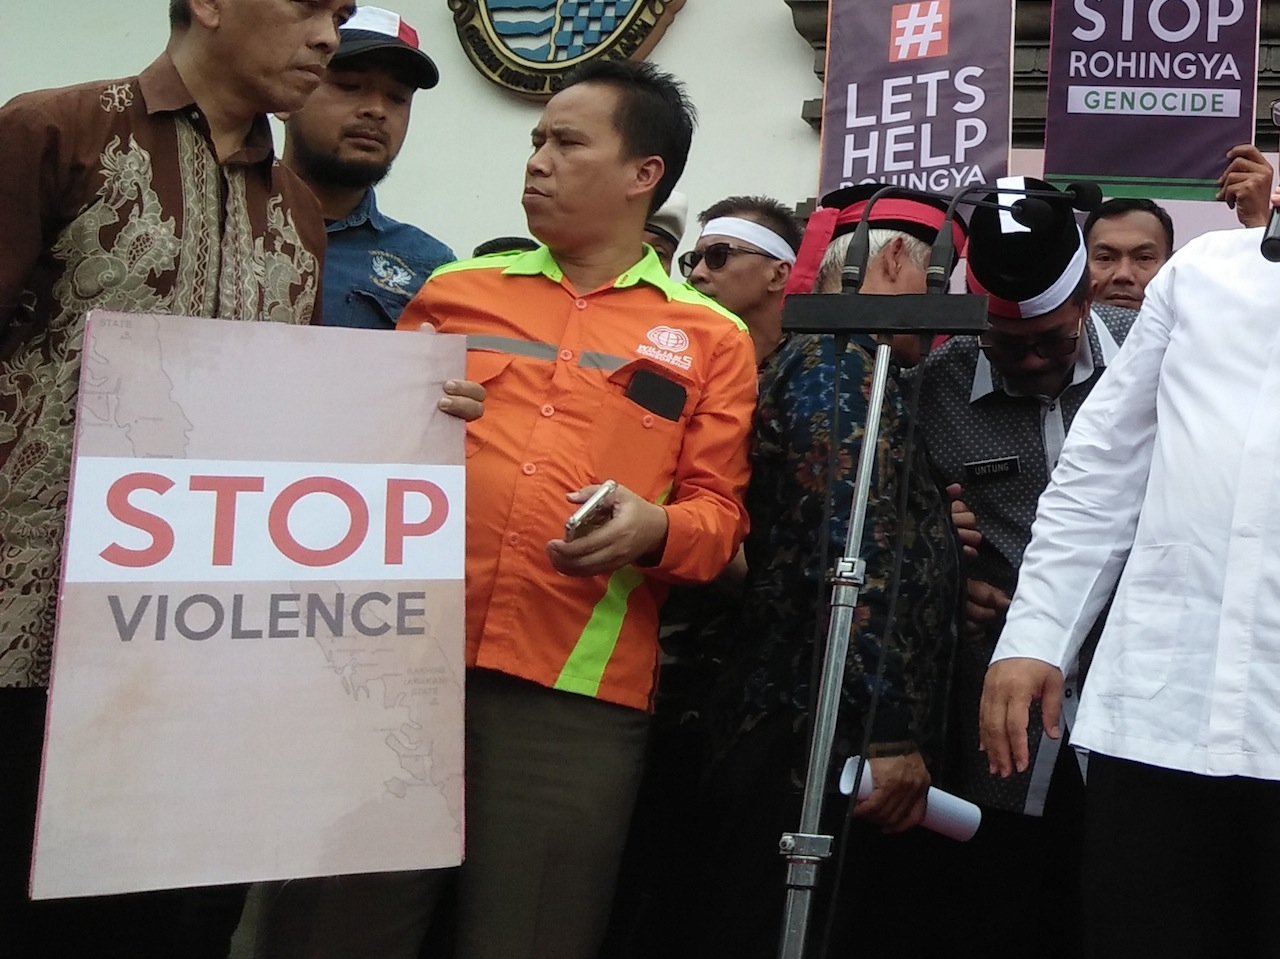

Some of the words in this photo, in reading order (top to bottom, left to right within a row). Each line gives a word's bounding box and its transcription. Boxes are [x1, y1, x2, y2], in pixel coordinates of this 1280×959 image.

[1068, 50, 1242, 81] ROHINGYA
[845, 65, 986, 129] LETS
[1084, 90, 1225, 113] GENOCIDE
[842, 117, 988, 179] HELP
[974, 462, 1009, 475] UNTUNG
[98, 472, 450, 568] STOP
[107, 591, 426, 641] VIOLENCE
